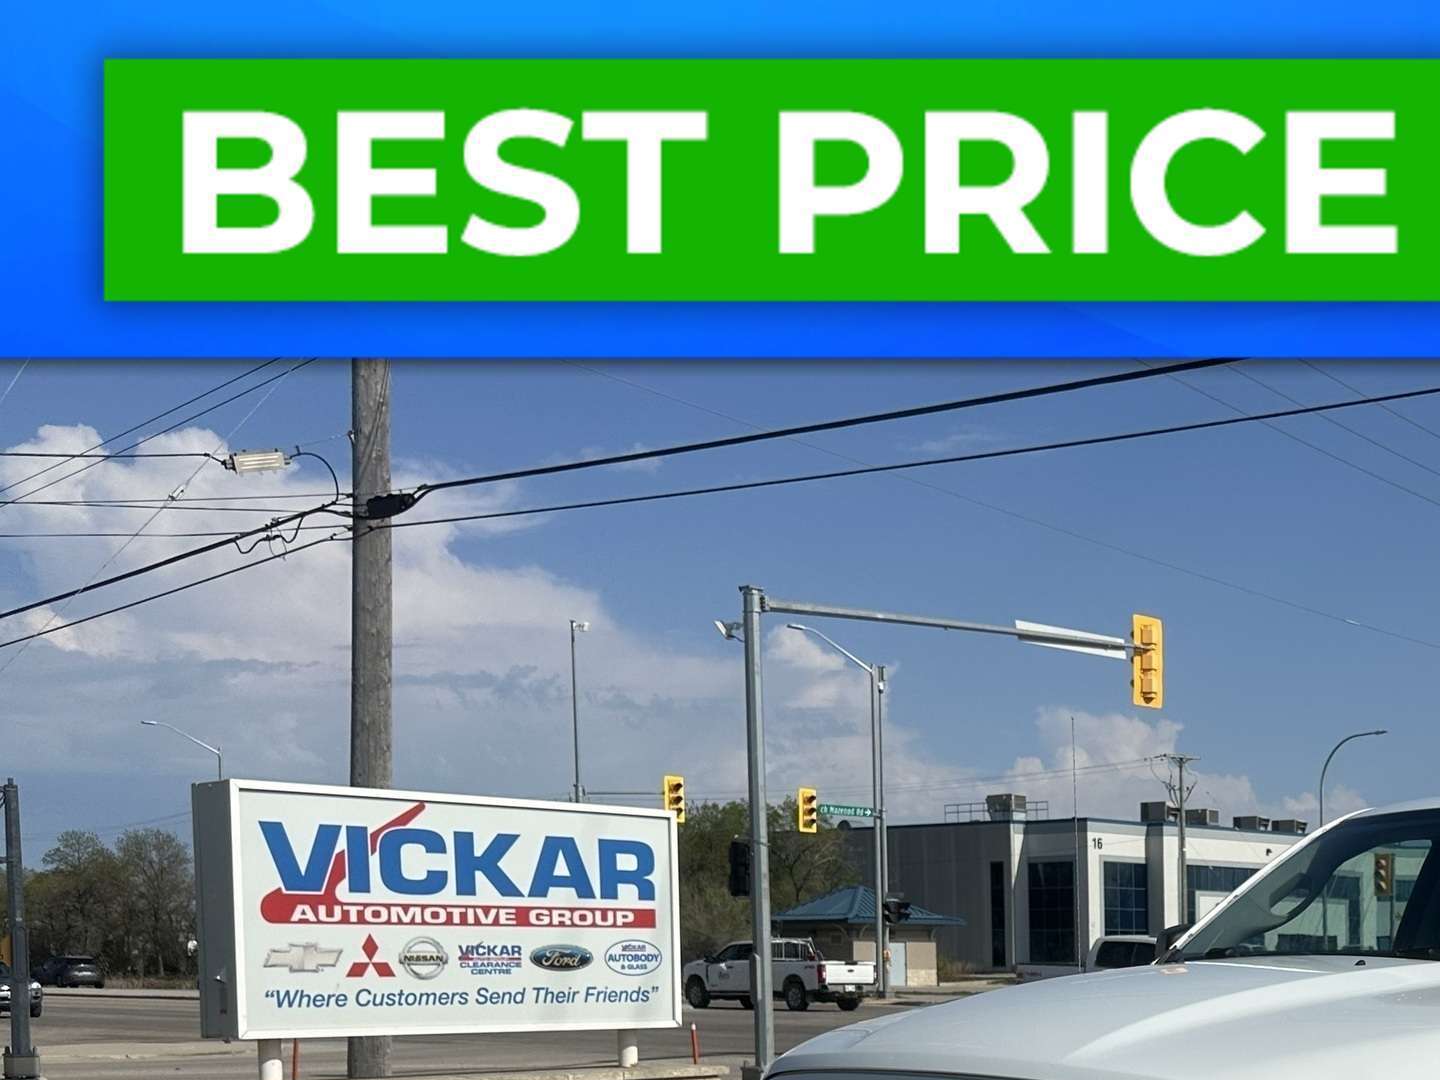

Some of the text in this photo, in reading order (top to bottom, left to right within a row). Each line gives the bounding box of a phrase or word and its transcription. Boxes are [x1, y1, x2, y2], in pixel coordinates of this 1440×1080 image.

[1092, 838, 1103, 849] 16
[258, 818, 656, 902] VICKAR
[290, 904, 636, 926] AUTOMOTIVE GROUP
[458, 943, 522, 957] VICKAR
[403, 954, 444, 963] NISSAN
[541, 950, 582, 968] Ford
[607, 954, 660, 963] AUTOBODY
[459, 961, 523, 969] CLEARANCE
[627, 963, 649, 971] GLASS
[470, 968, 513, 976] CENTRE
[355, 987, 469, 1007] Customers
[475, 986, 526, 1005] Send
[532, 986, 580, 1005] Their
